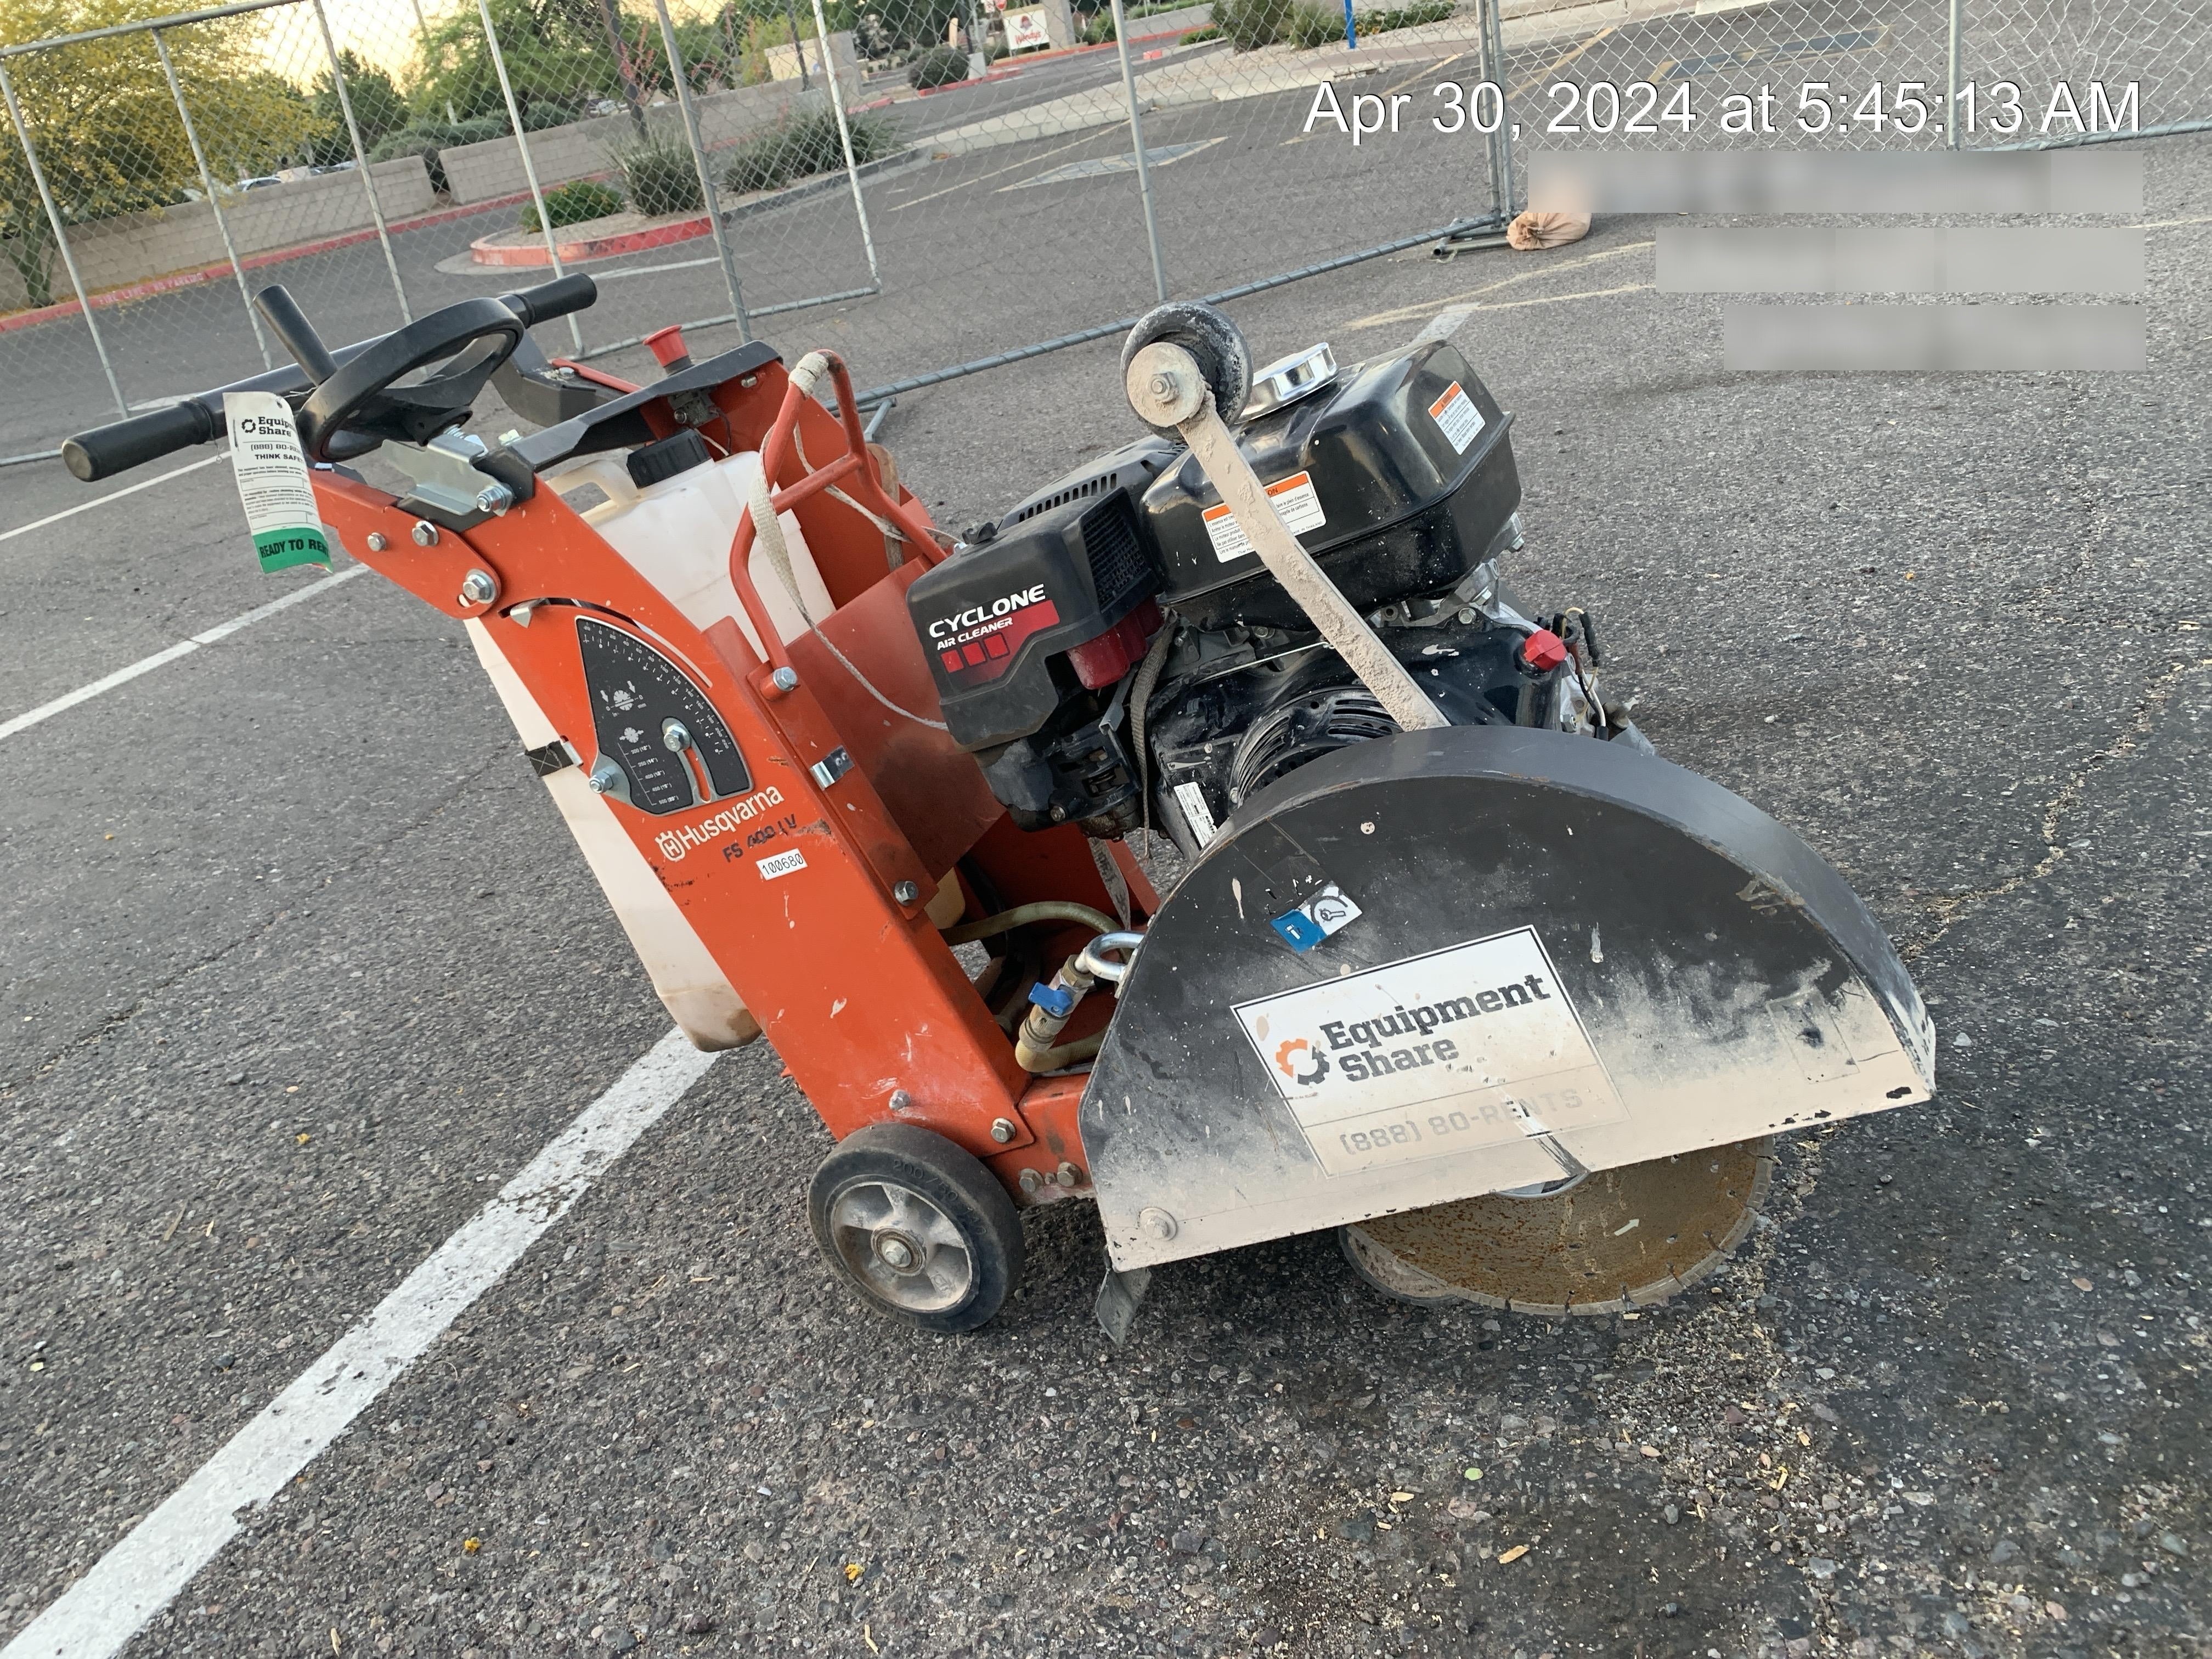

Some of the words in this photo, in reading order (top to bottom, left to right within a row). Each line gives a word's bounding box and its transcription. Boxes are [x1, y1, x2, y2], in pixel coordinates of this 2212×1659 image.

[1015, 31, 1041, 44] Wendy's
[259, 426, 292, 437] Share
[251, 443, 273, 451] (888)
[259, 541, 286, 558] READY
[288, 539, 304, 551] TO
[929, 583, 1046, 638] CYCLONE
[937, 637, 956, 651] AIR
[958, 617, 1014, 643] CLEANER
[675, 786, 785, 850] Husqvarna
[722, 842, 744, 864] FS
[761, 853, 804, 875] 100680
[1319, 974, 1552, 1051] Equipment
[1339, 1039, 1460, 1082] Share
[1340, 1120, 1423, 1155] (888)
